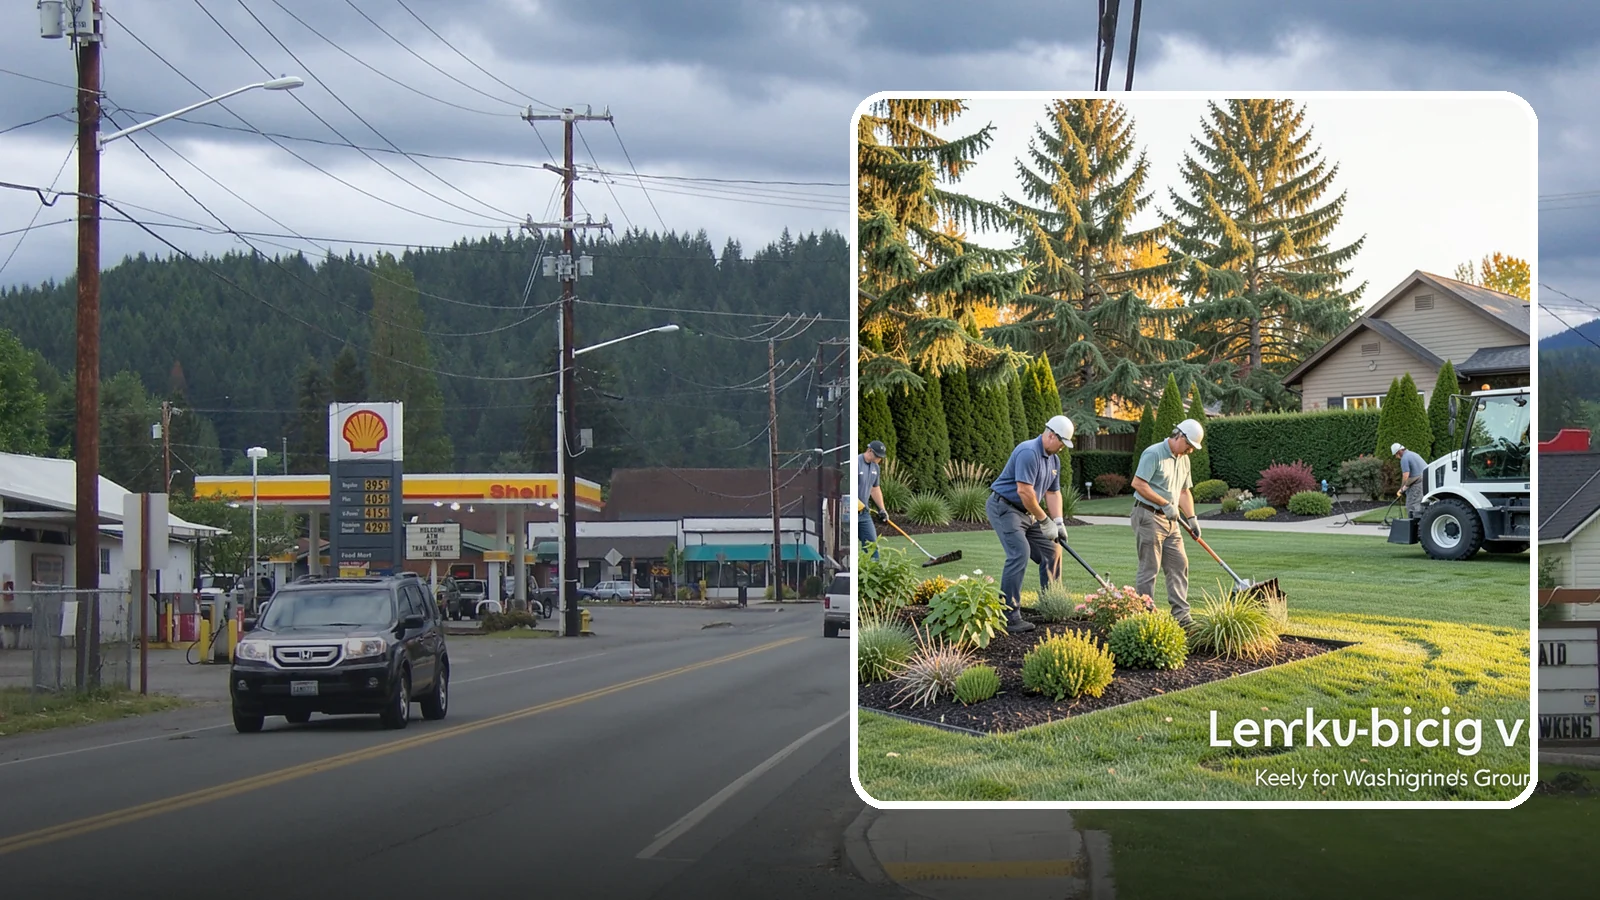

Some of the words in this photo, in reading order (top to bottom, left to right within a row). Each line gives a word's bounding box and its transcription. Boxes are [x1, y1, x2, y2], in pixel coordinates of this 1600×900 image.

[366, 480, 383, 490] 395
[490, 484, 547, 498] Shell
[366, 494, 383, 504] 405
[366, 508, 383, 518] 415
[366, 522, 383, 532] 429
